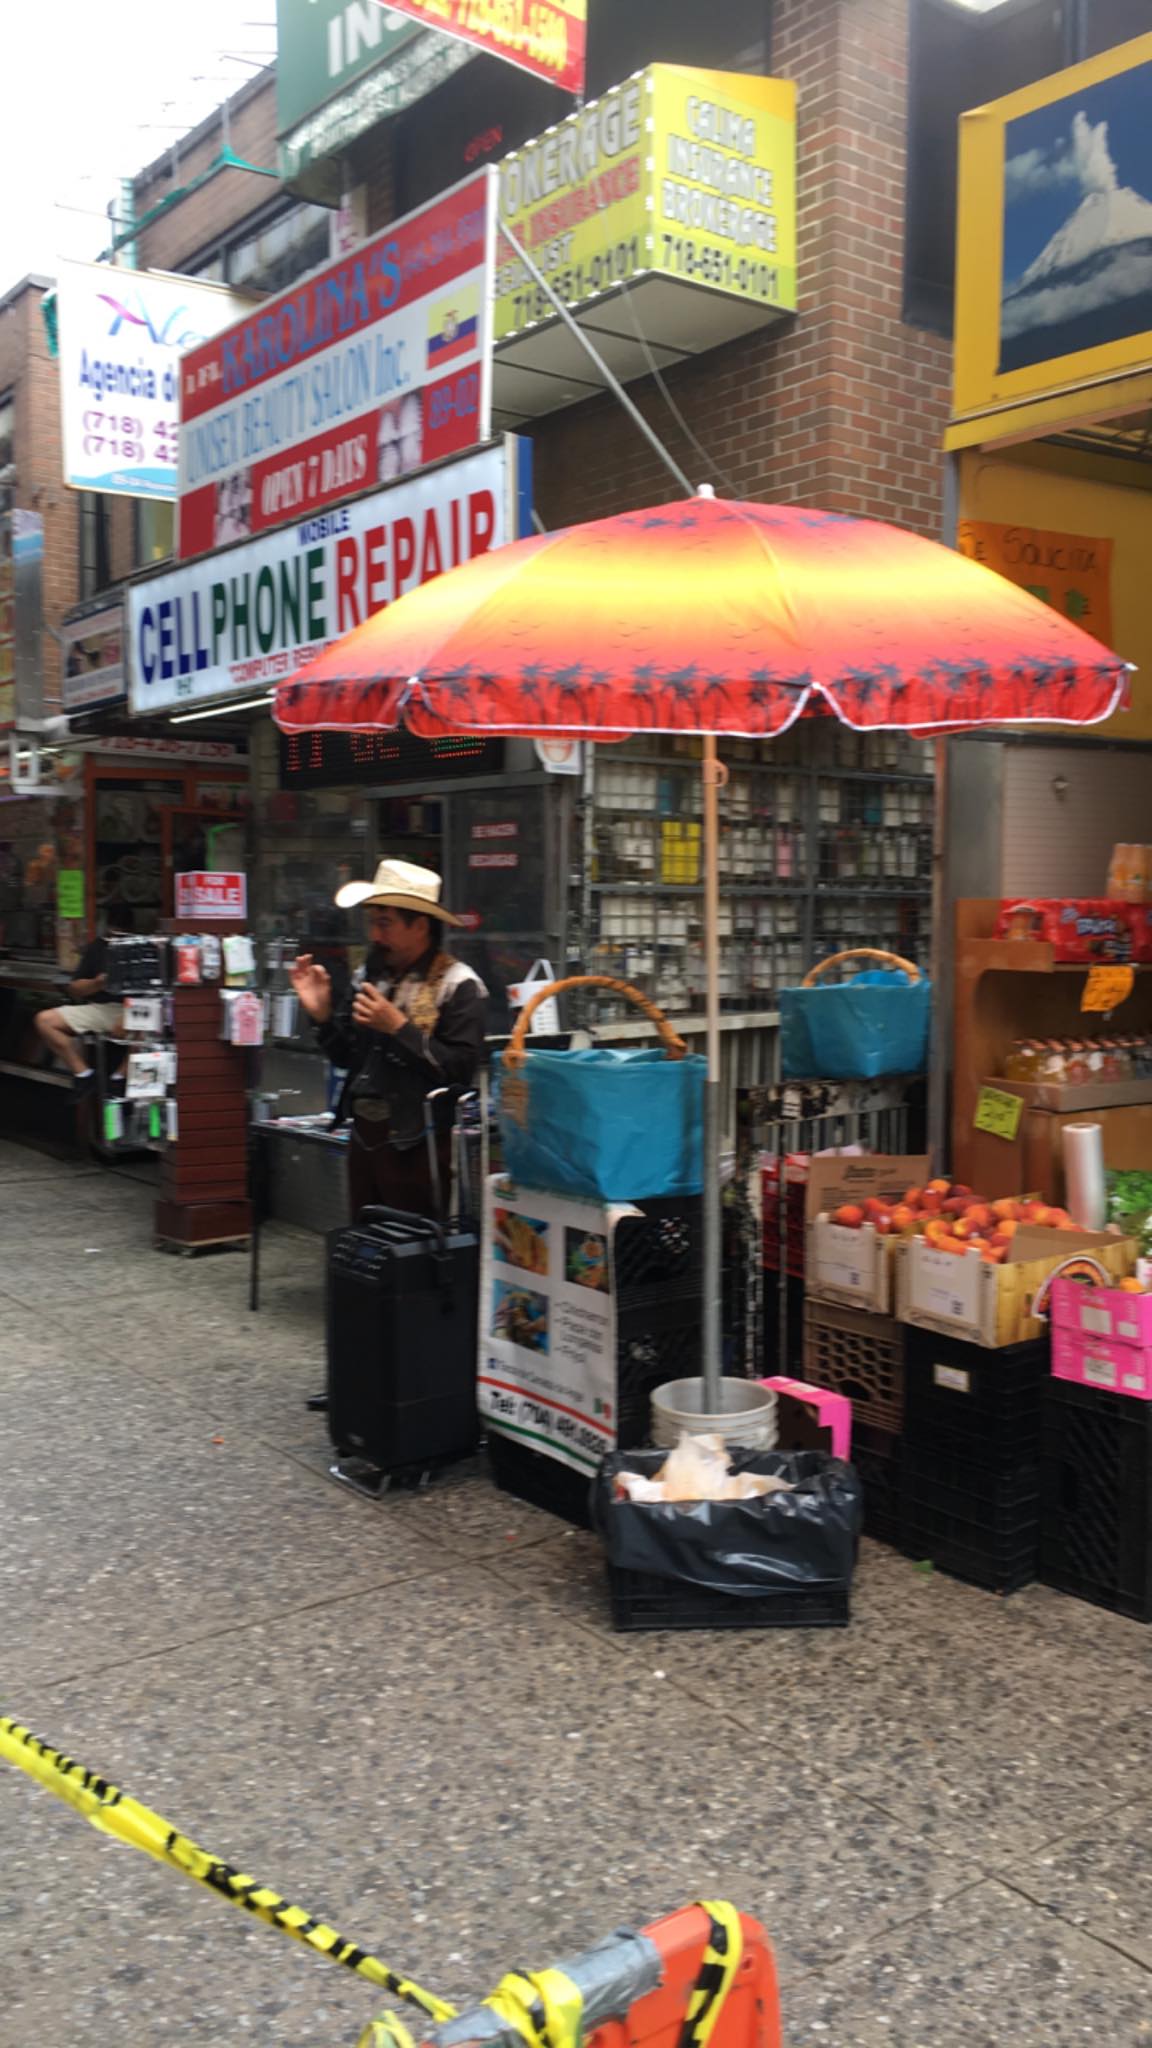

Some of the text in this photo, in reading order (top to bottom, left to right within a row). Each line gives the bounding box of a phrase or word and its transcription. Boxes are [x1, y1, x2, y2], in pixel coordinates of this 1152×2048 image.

[668, 133, 773, 208] INSURANCE
[662, 178, 777, 254] BROKERAGE
[662, 233, 779, 300] 718-651-0101
[222, 242, 401, 394] KAROLINA'S
[79, 349, 157, 402] Agencia
[82, 410, 144, 440] (718)
[186, 412, 237, 484] UNISEX
[243, 372, 305, 458] BEAUTY
[311, 340, 371, 426] SALON
[82, 434, 145, 463] (718)
[260, 434, 369, 516] OPEN 7 DAYS
[299, 509, 351, 546] MOBILE
[336, 489, 495, 633] REPAIR
[228, 653, 288, 683] COMPUTER
[194, 887, 241, 904] SALE
